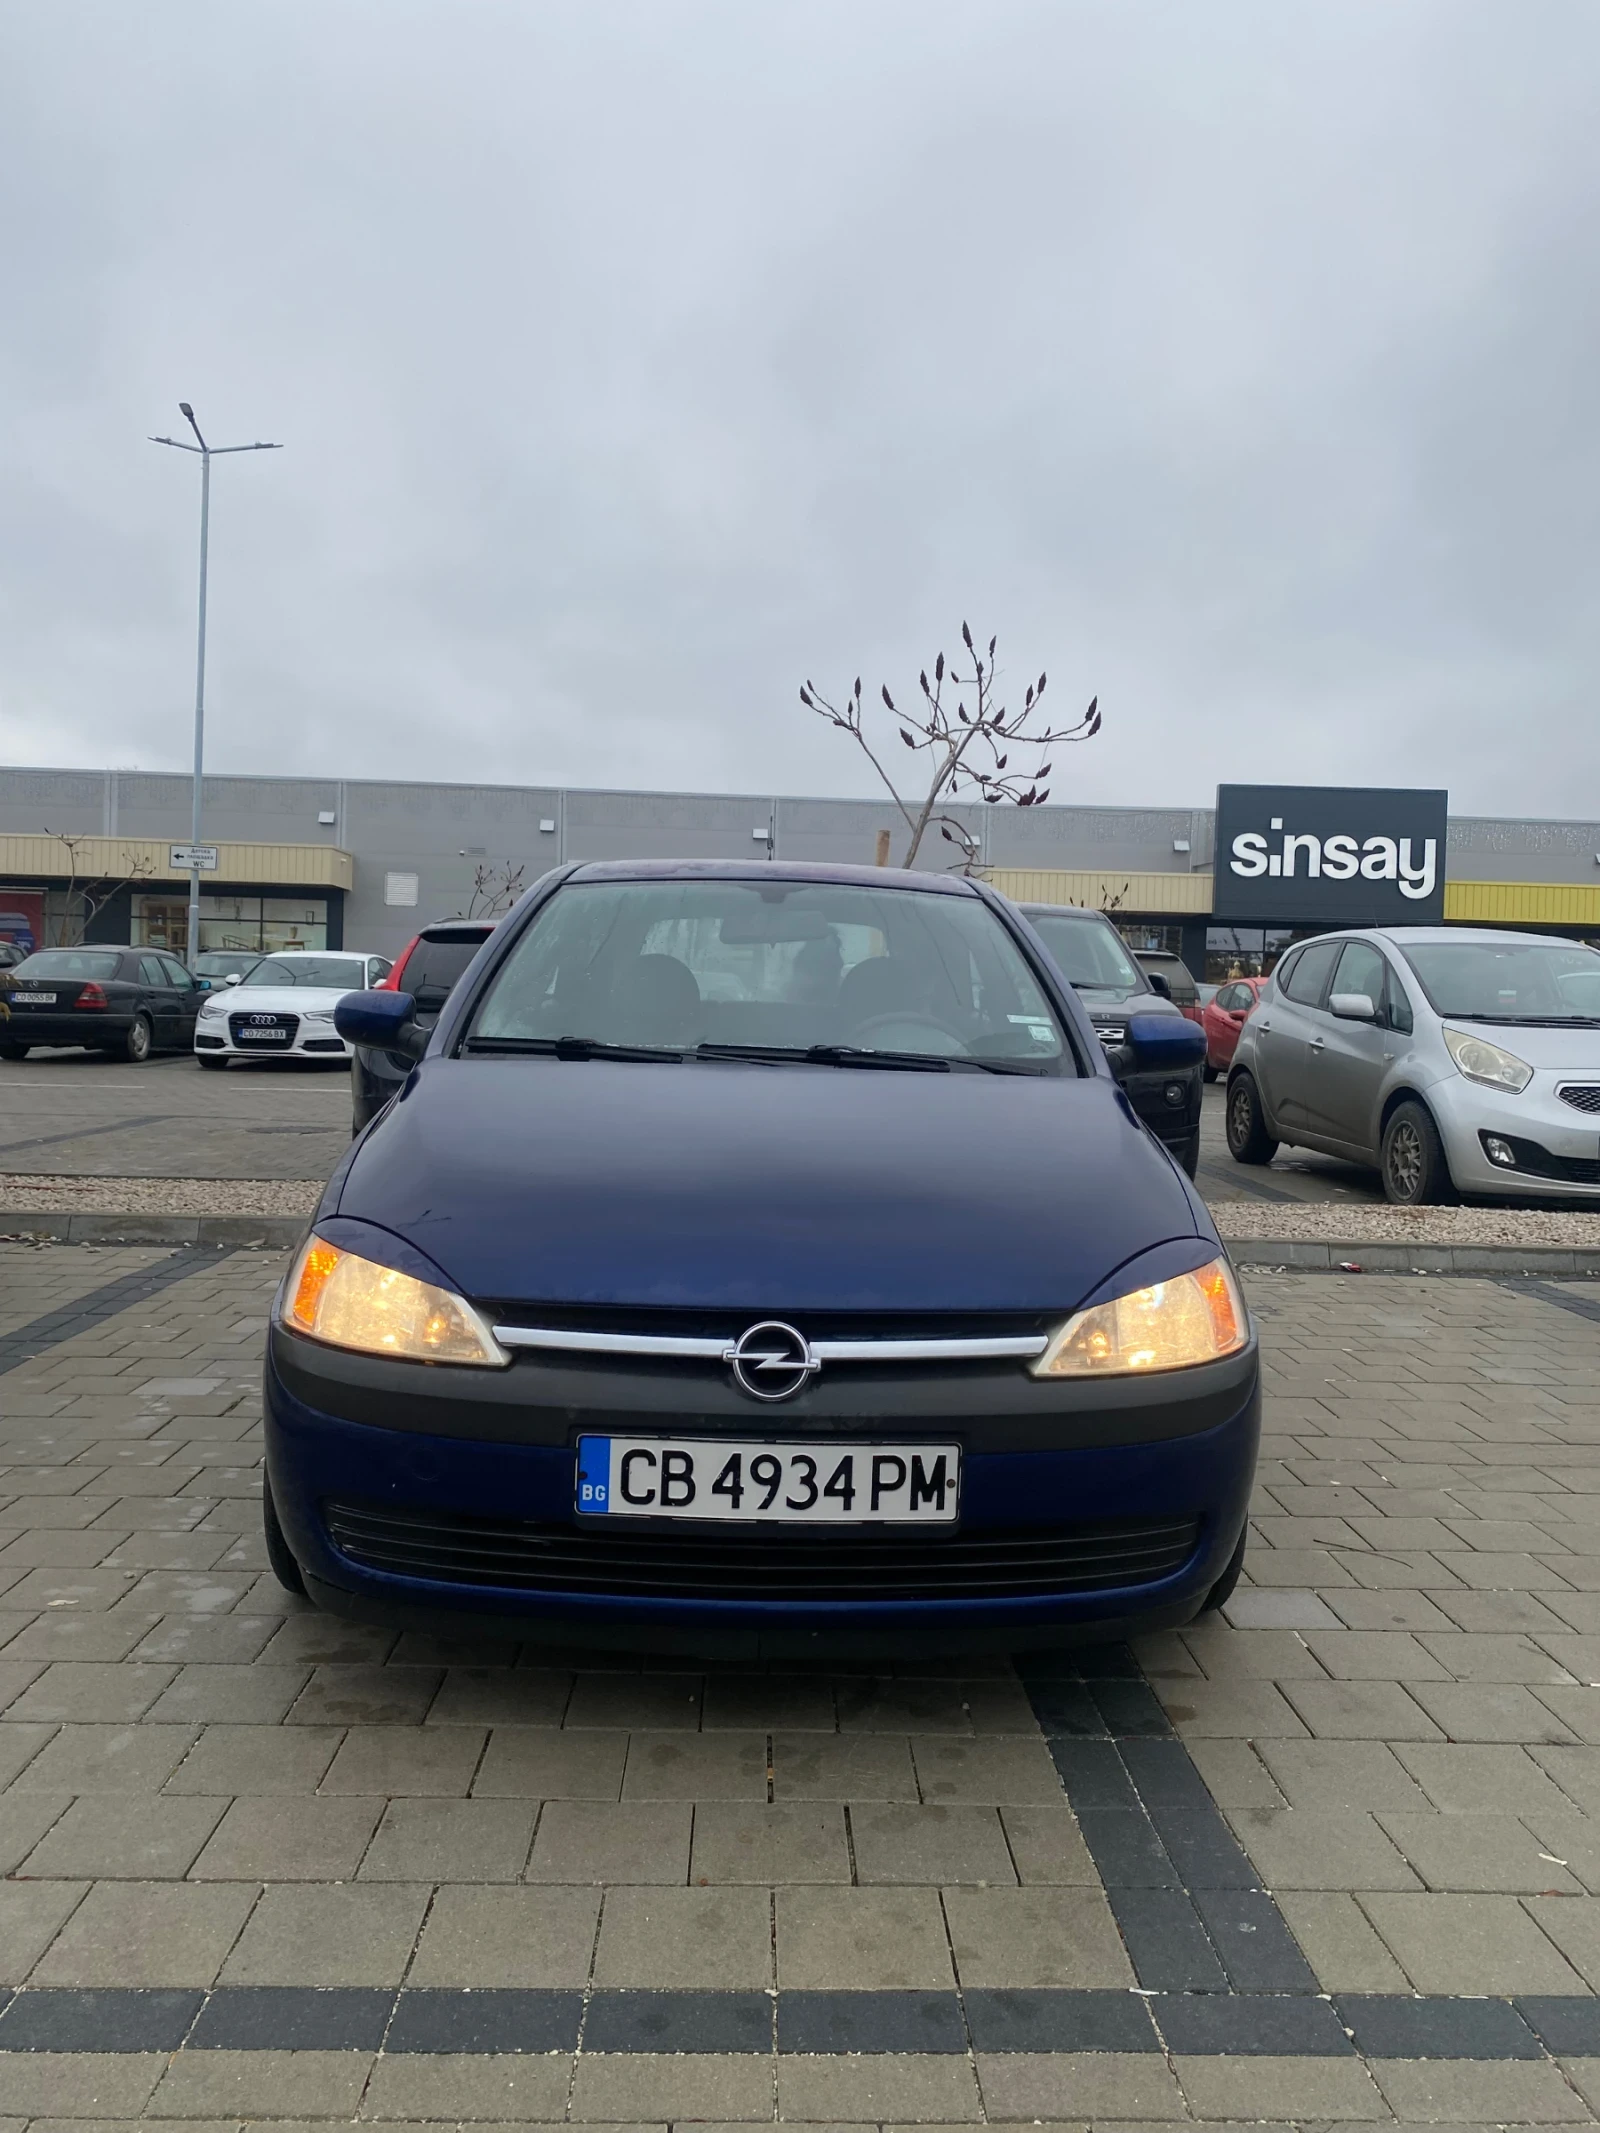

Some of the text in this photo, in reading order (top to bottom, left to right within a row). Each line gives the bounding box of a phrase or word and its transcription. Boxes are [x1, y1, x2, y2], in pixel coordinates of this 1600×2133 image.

[1230, 817, 1437, 900] sinsay
[582, 1484, 606, 1501] BG
[620, 1448, 947, 1511] CB 4934 PM
